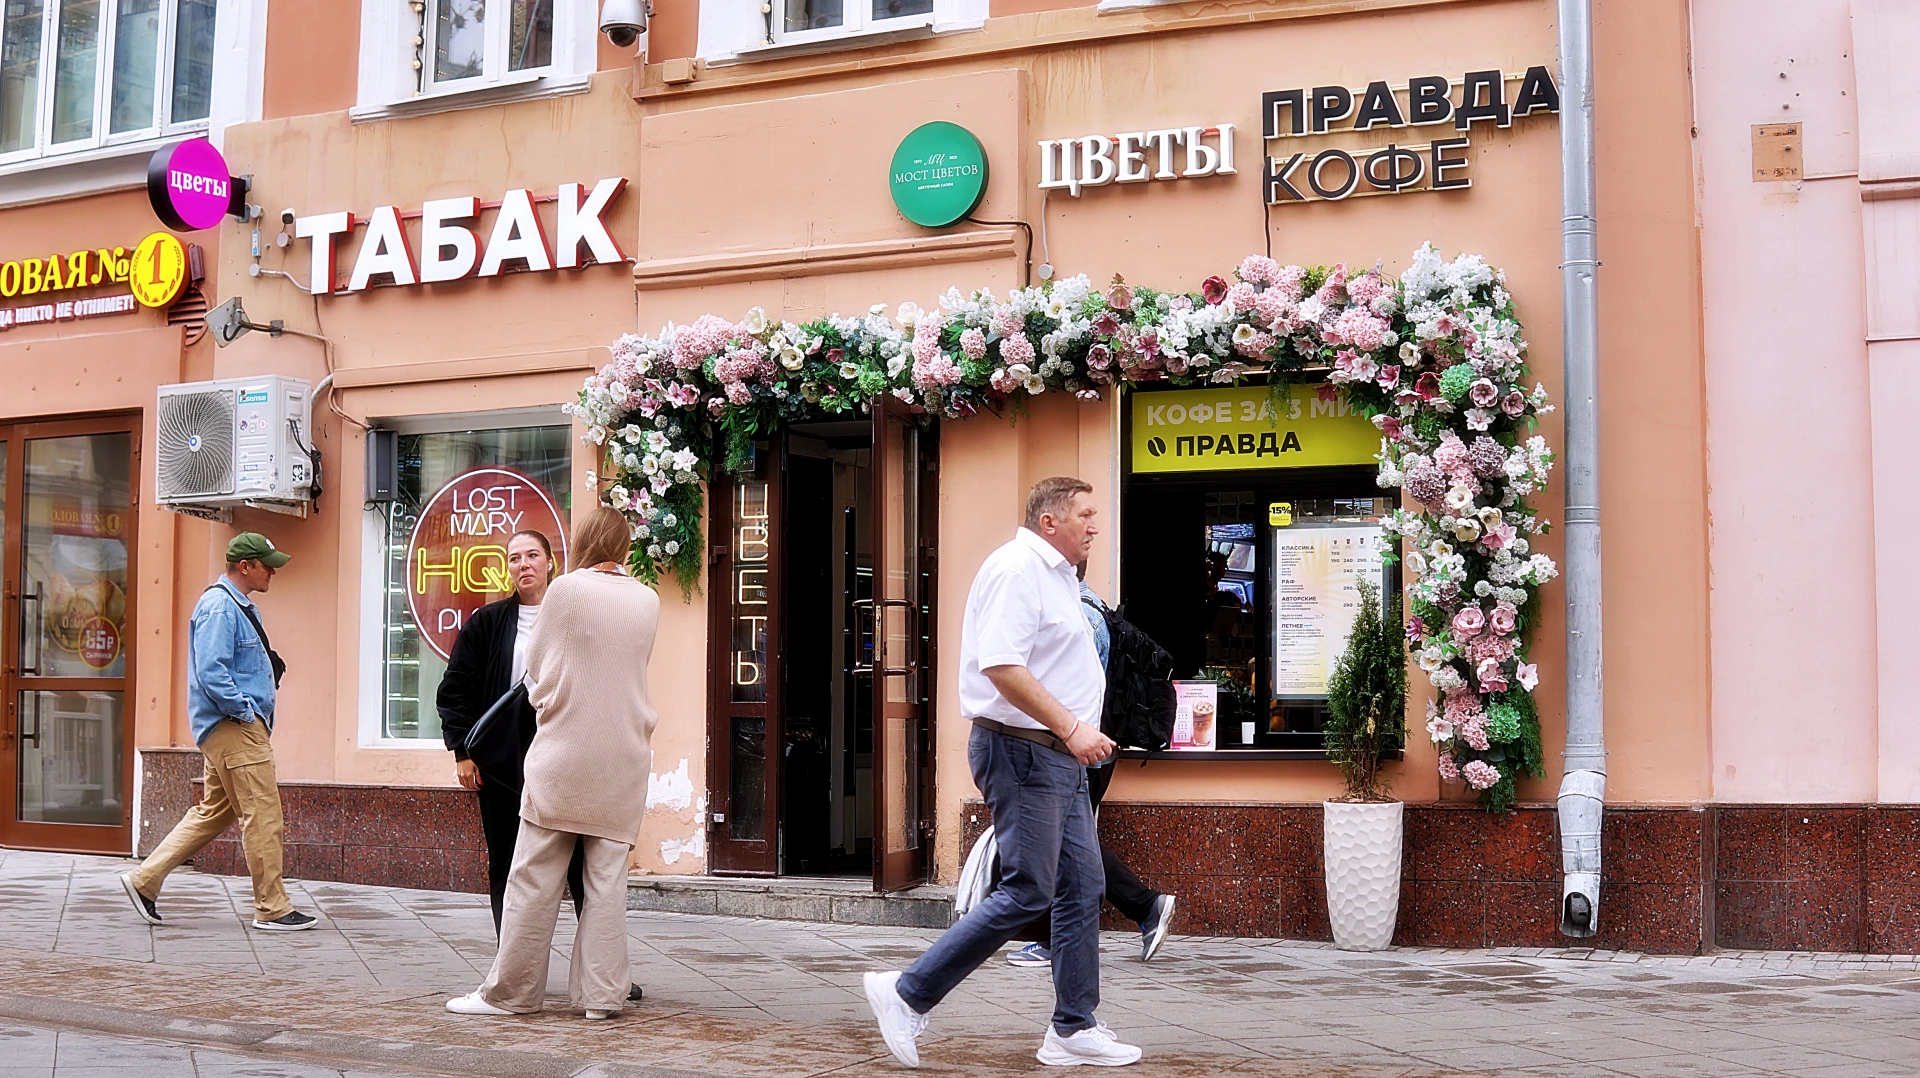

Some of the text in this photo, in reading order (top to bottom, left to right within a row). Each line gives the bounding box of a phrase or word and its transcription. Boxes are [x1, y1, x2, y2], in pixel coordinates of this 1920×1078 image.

[1262, 65, 1560, 139] ПРАВДА
[895, 164, 979, 184] МОСТ ЦВЕТОВ
[1037, 123, 1238, 198] ЦВЕТЫ
[1265, 137, 1472, 205] КОФЕ
[295, 177, 629, 295] ТАБАК
[147, 239, 166, 285] 1
[15, 305, 53, 323] НИКТО
[55, 302, 73, 318] НЕ
[74, 294, 135, 316] ОТНИМЕТ!
[1147, 401, 1232, 426] КОФЕ
[1311, 396, 1365, 419] МИ
[1176, 431, 1302, 458] ПРАВДА
[453, 485, 522, 513] LOST
[1268, 506, 1292, 515] -15%
[450, 511, 524, 537] MARY
